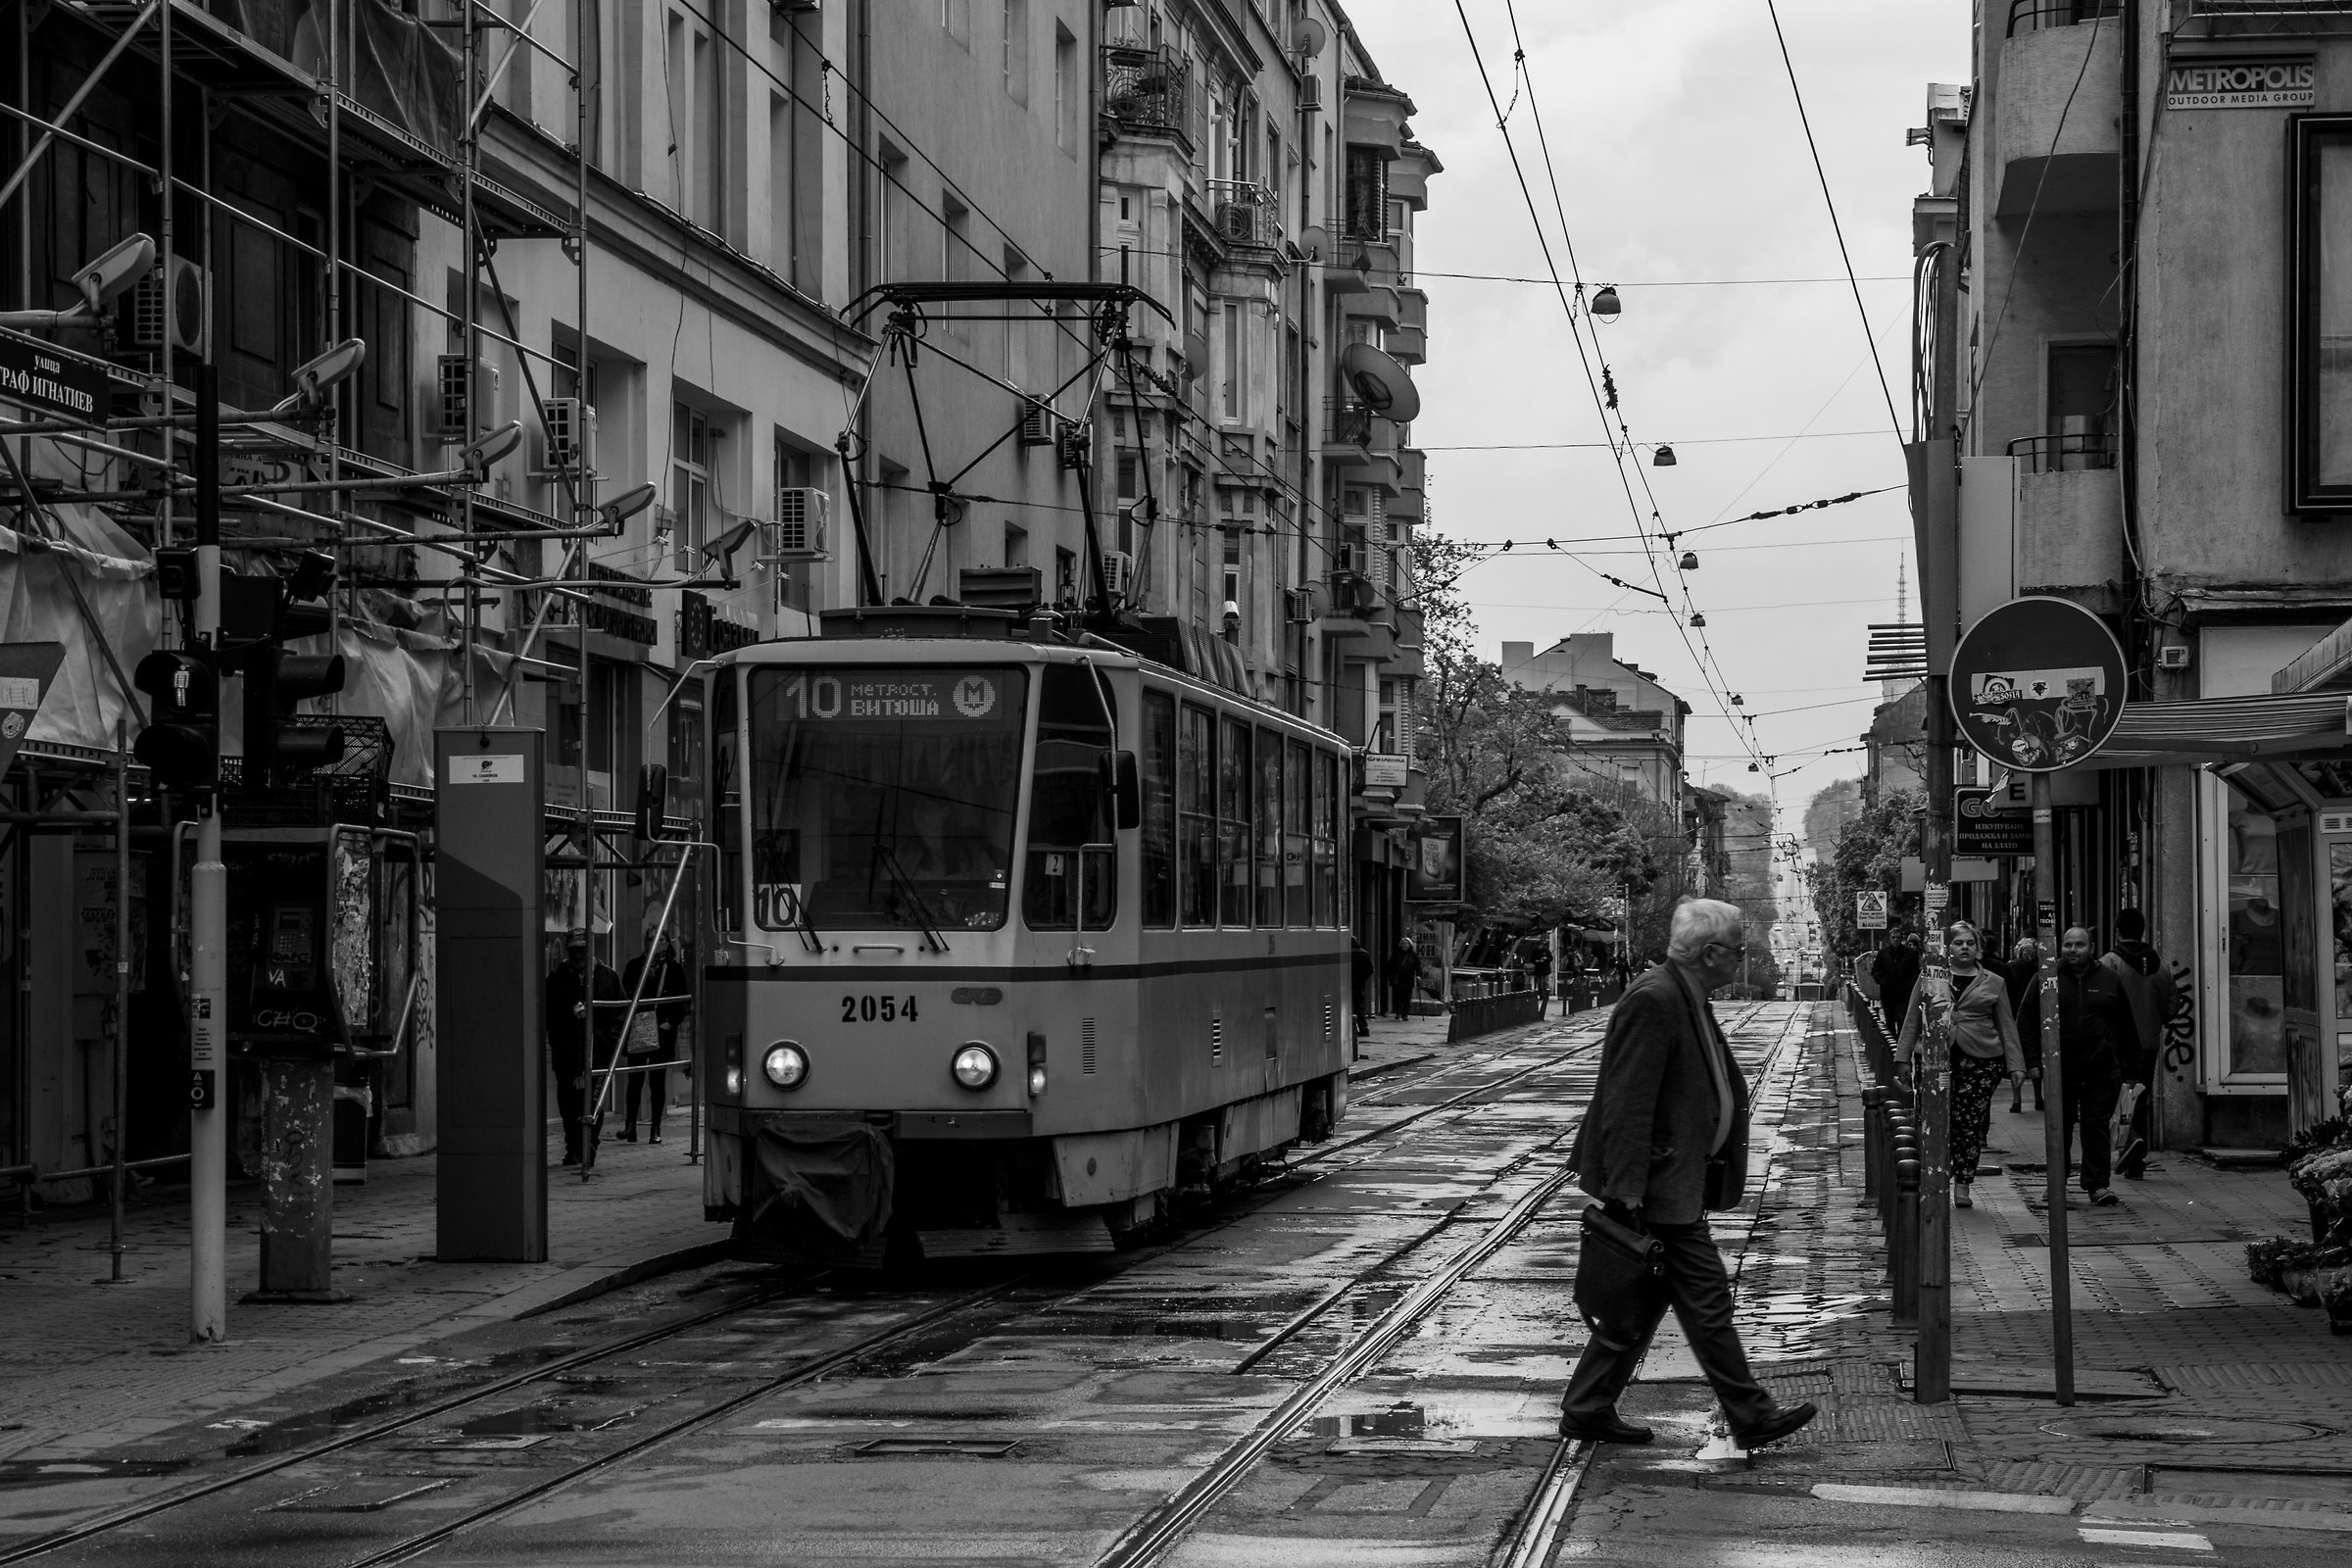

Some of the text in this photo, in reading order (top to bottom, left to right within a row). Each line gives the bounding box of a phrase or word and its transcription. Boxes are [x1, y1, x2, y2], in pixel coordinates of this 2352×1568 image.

[2168, 65, 2314, 92] METROPOLIS
[2169, 92, 2314, 106] OUTDOOR MEDIA GROUP
[33, 354, 61, 374] улица
[32, 375, 94, 414] ИГНАТИЕВ
[786, 676, 841, 718] 10
[851, 700, 940, 716] ВИТОША
[1053, 856, 1058, 872] 2
[759, 887, 797, 926] 10
[842, 995, 918, 1023] 2054
